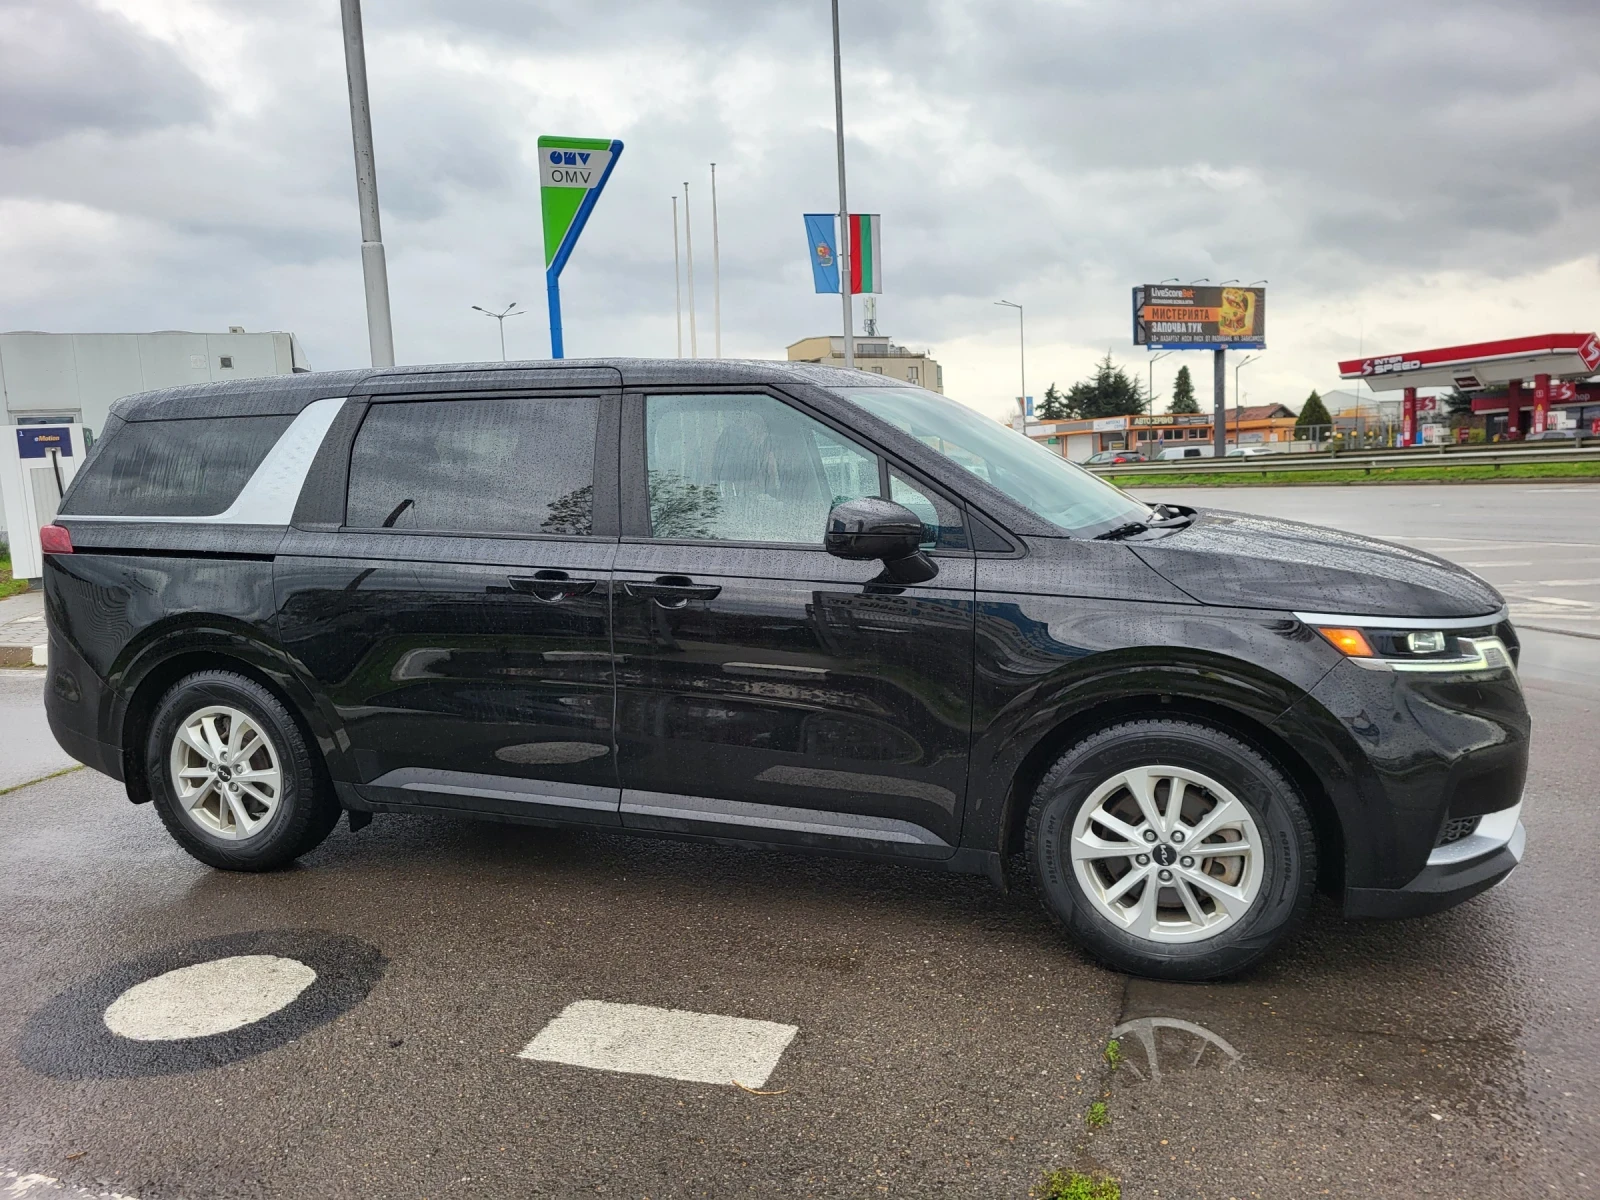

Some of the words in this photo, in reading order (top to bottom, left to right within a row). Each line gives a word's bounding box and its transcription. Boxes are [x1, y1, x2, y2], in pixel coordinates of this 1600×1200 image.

[551, 169, 592, 184] OMV
[1151, 307, 1210, 320] МИСТЕРИЯТА
[1151, 321, 1188, 333] ЗАПОЧВА
[1188, 322, 1203, 333] ТУК
[1374, 356, 1403, 365] INTER
[1374, 360, 1421, 374] SPEED
[1279, 830, 1292, 882] ROTATION
